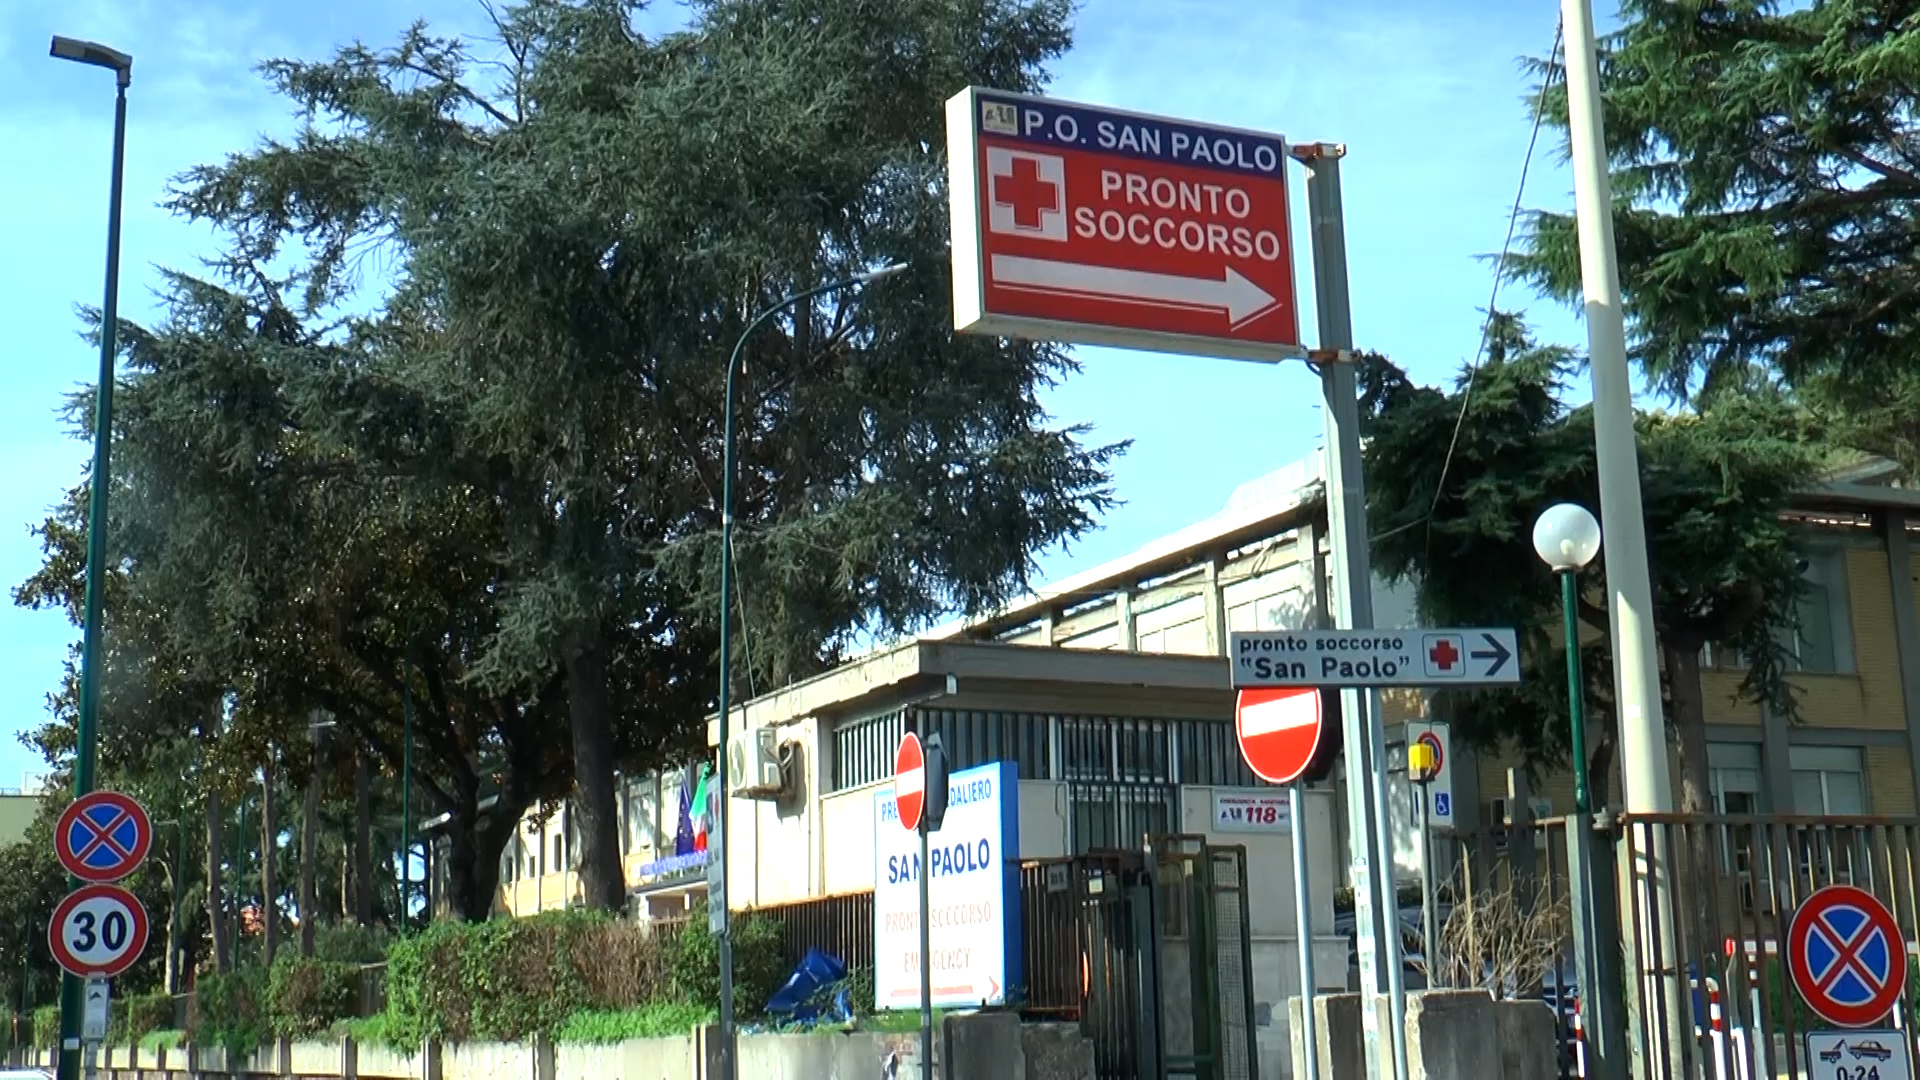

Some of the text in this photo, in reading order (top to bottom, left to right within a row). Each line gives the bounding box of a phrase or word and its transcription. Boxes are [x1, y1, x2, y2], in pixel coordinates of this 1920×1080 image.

[1024, 109, 1087, 144] P.O.
[1097, 121, 1161, 155] SAN
[1171, 132, 1277, 172] PAOLO
[1101, 169, 1251, 219] PRONTO
[1074, 206, 1280, 261] SOCCORSO
[1239, 635, 1404, 654] pronto soccorso
[947, 777, 992, 807] DALIERO
[1245, 806, 1277, 825] 118
[931, 837, 990, 878] PAOLO
[72, 910, 127, 952] 30
[885, 900, 992, 932] PRONT SOCCORSO
[904, 946, 971, 973] EMGENCY
